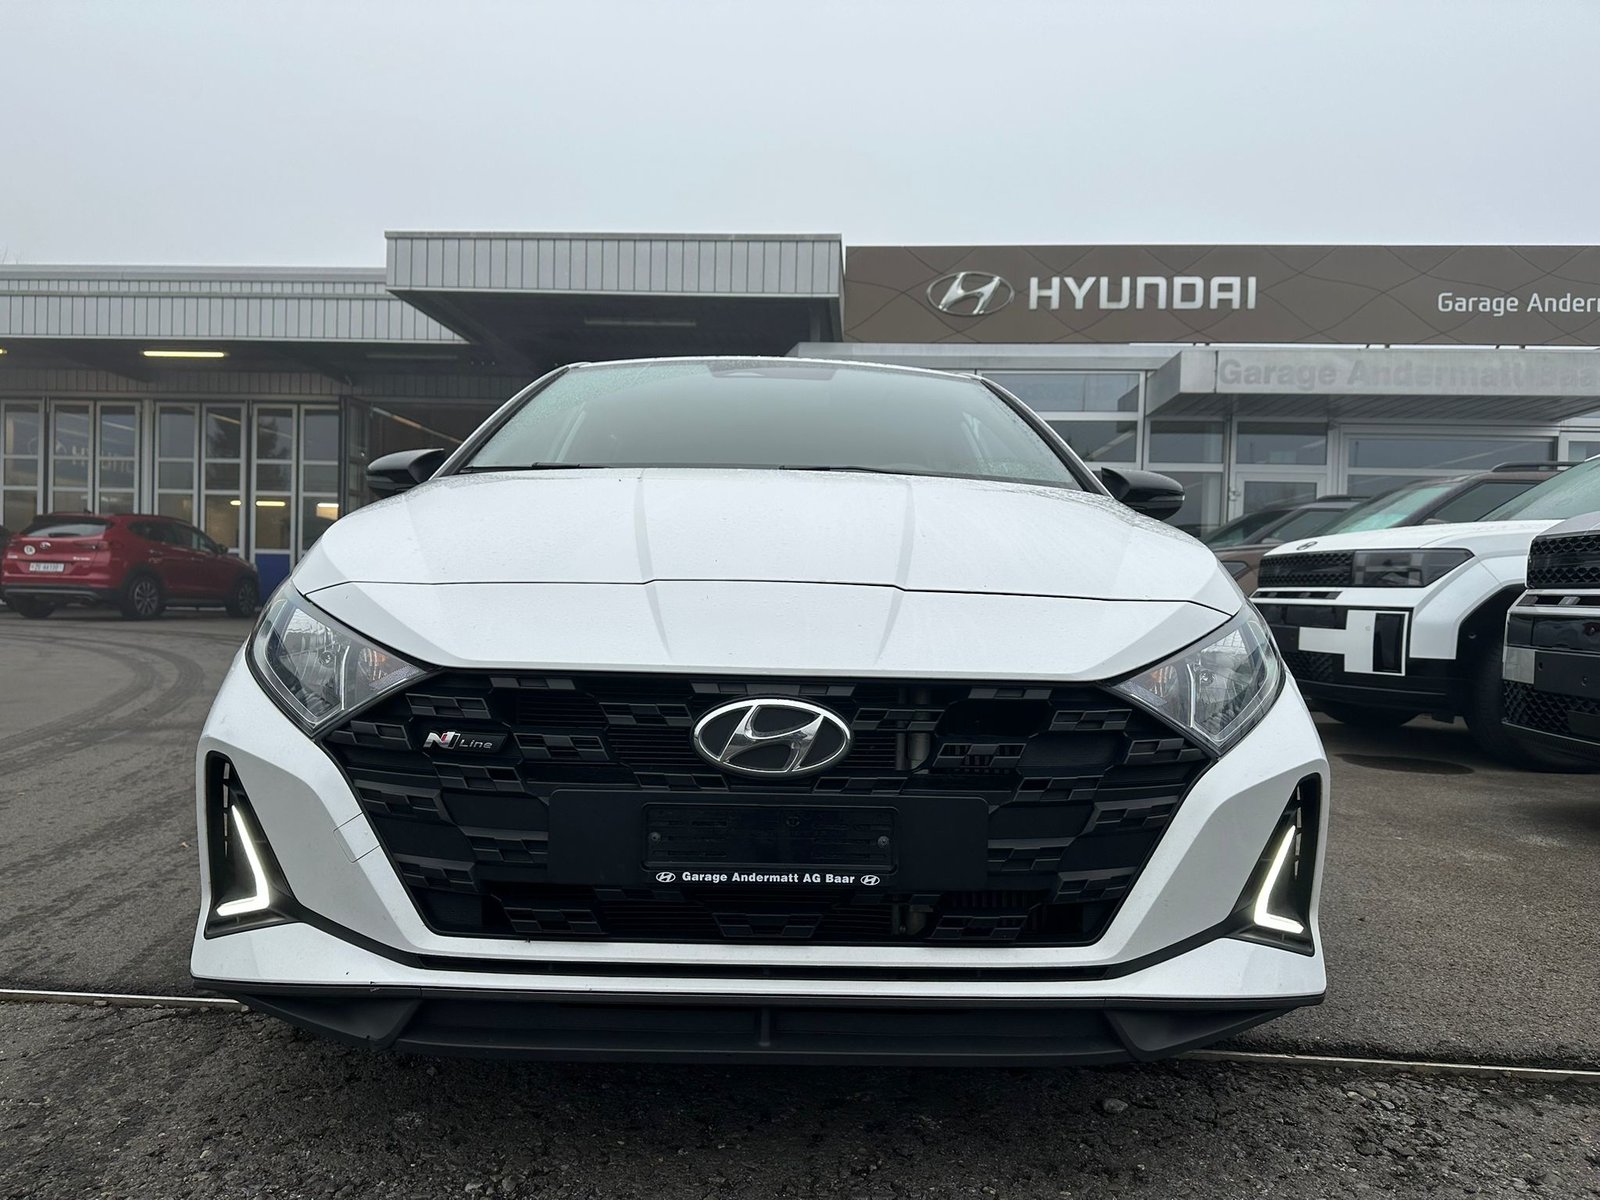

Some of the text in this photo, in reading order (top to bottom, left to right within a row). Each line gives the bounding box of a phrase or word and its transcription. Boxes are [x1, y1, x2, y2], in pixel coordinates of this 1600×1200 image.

[1029, 276, 1257, 310] HYUNDAI
[1438, 292, 1519, 317] Garage
[1219, 358, 1600, 391] Garage Andermatt Baa
[459, 739, 493, 749] Line
[682, 871, 855, 884] Garage Andermatt AG Baar
